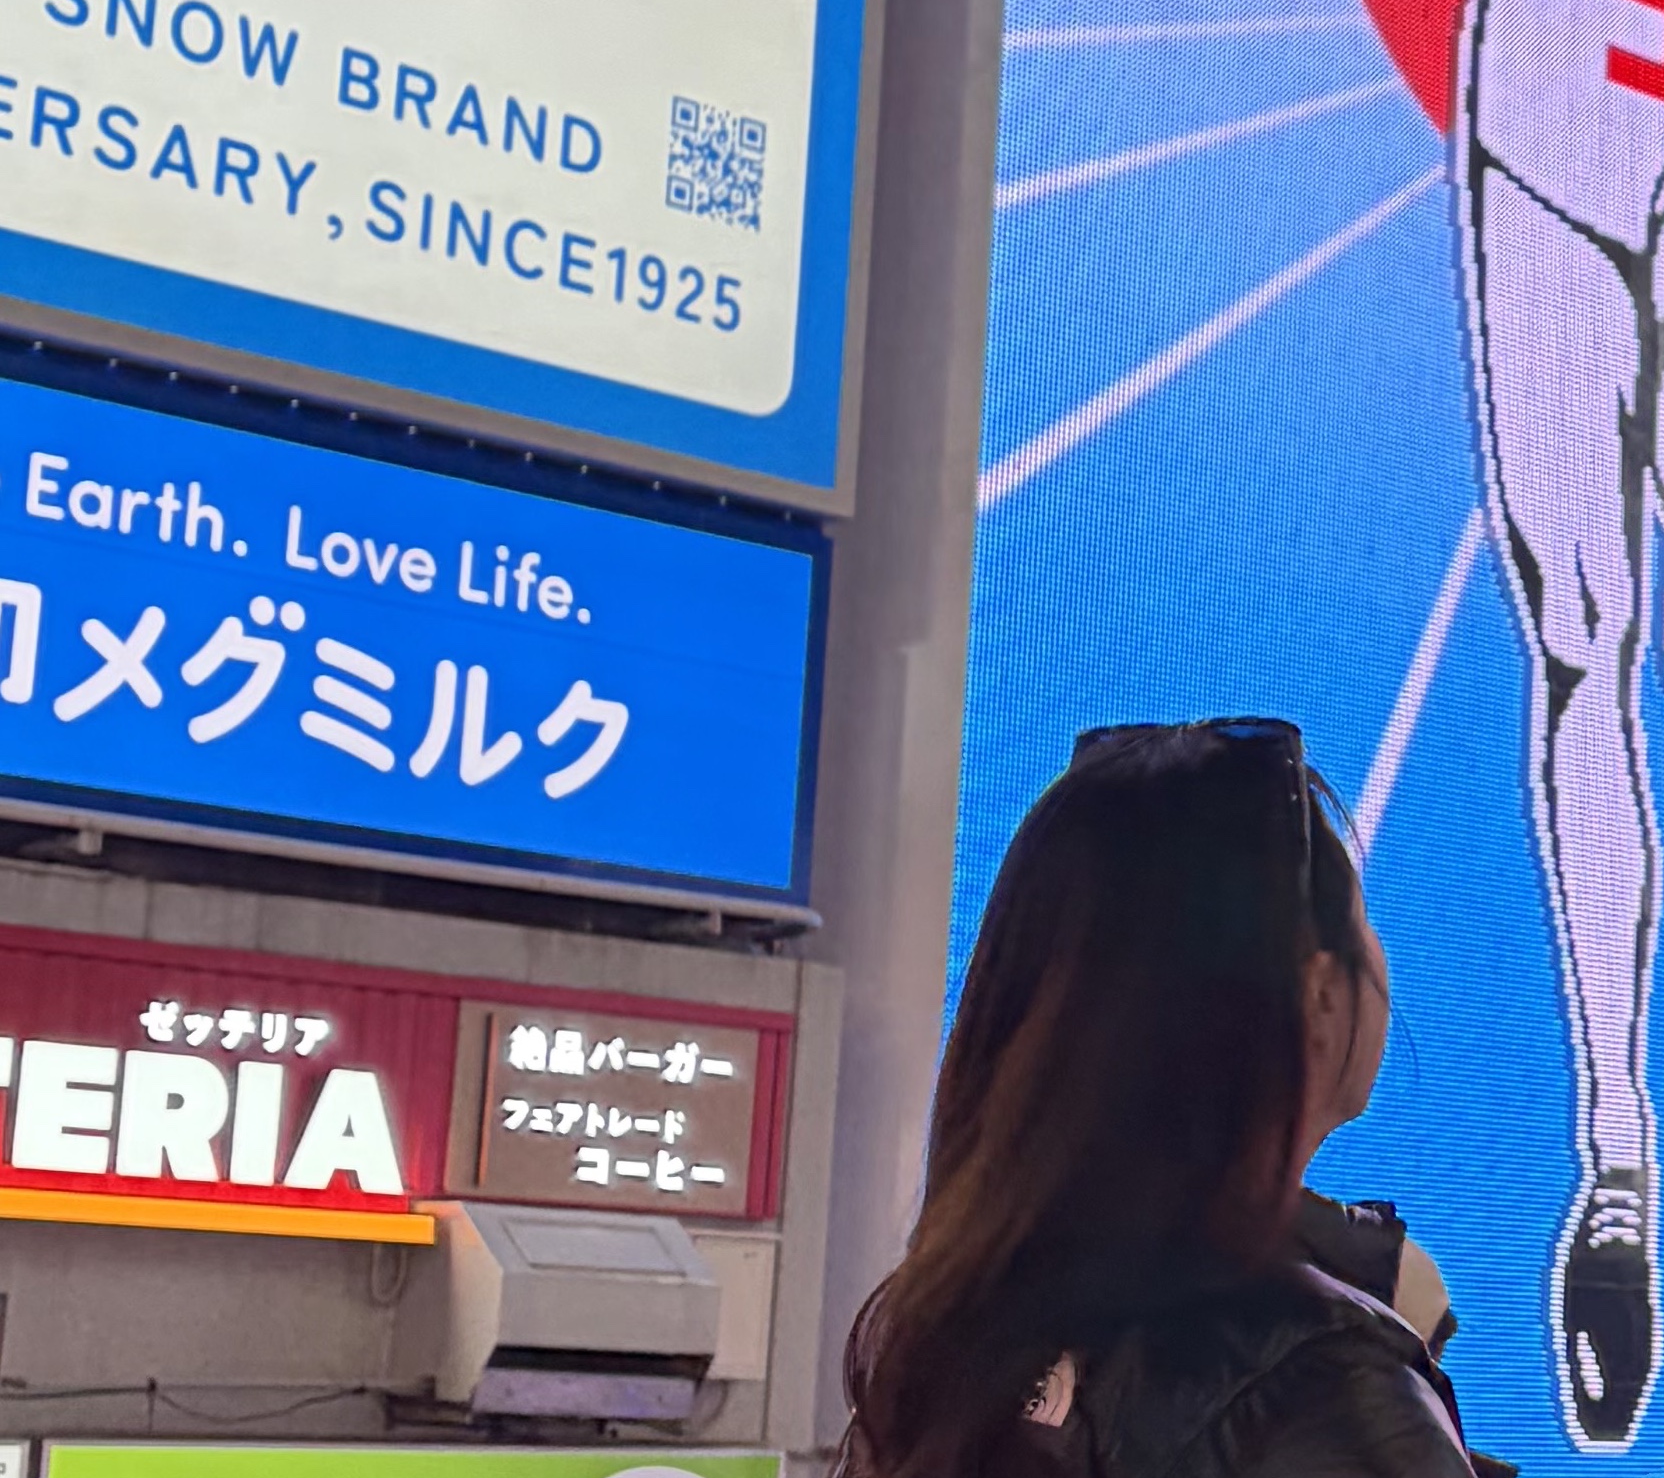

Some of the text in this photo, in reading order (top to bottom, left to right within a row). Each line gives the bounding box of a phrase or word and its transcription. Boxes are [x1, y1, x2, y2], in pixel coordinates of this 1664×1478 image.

[338, 46, 604, 175] BRAND
[25, 451, 592, 624] Earth. Love Life.
[139, 1000, 330, 1056] ゼッテリア
[0, 1037, 403, 1195] ERIA
[500, 1098, 687, 1145] フェアトレード
[575, 1146, 726, 1191] コーヒー
